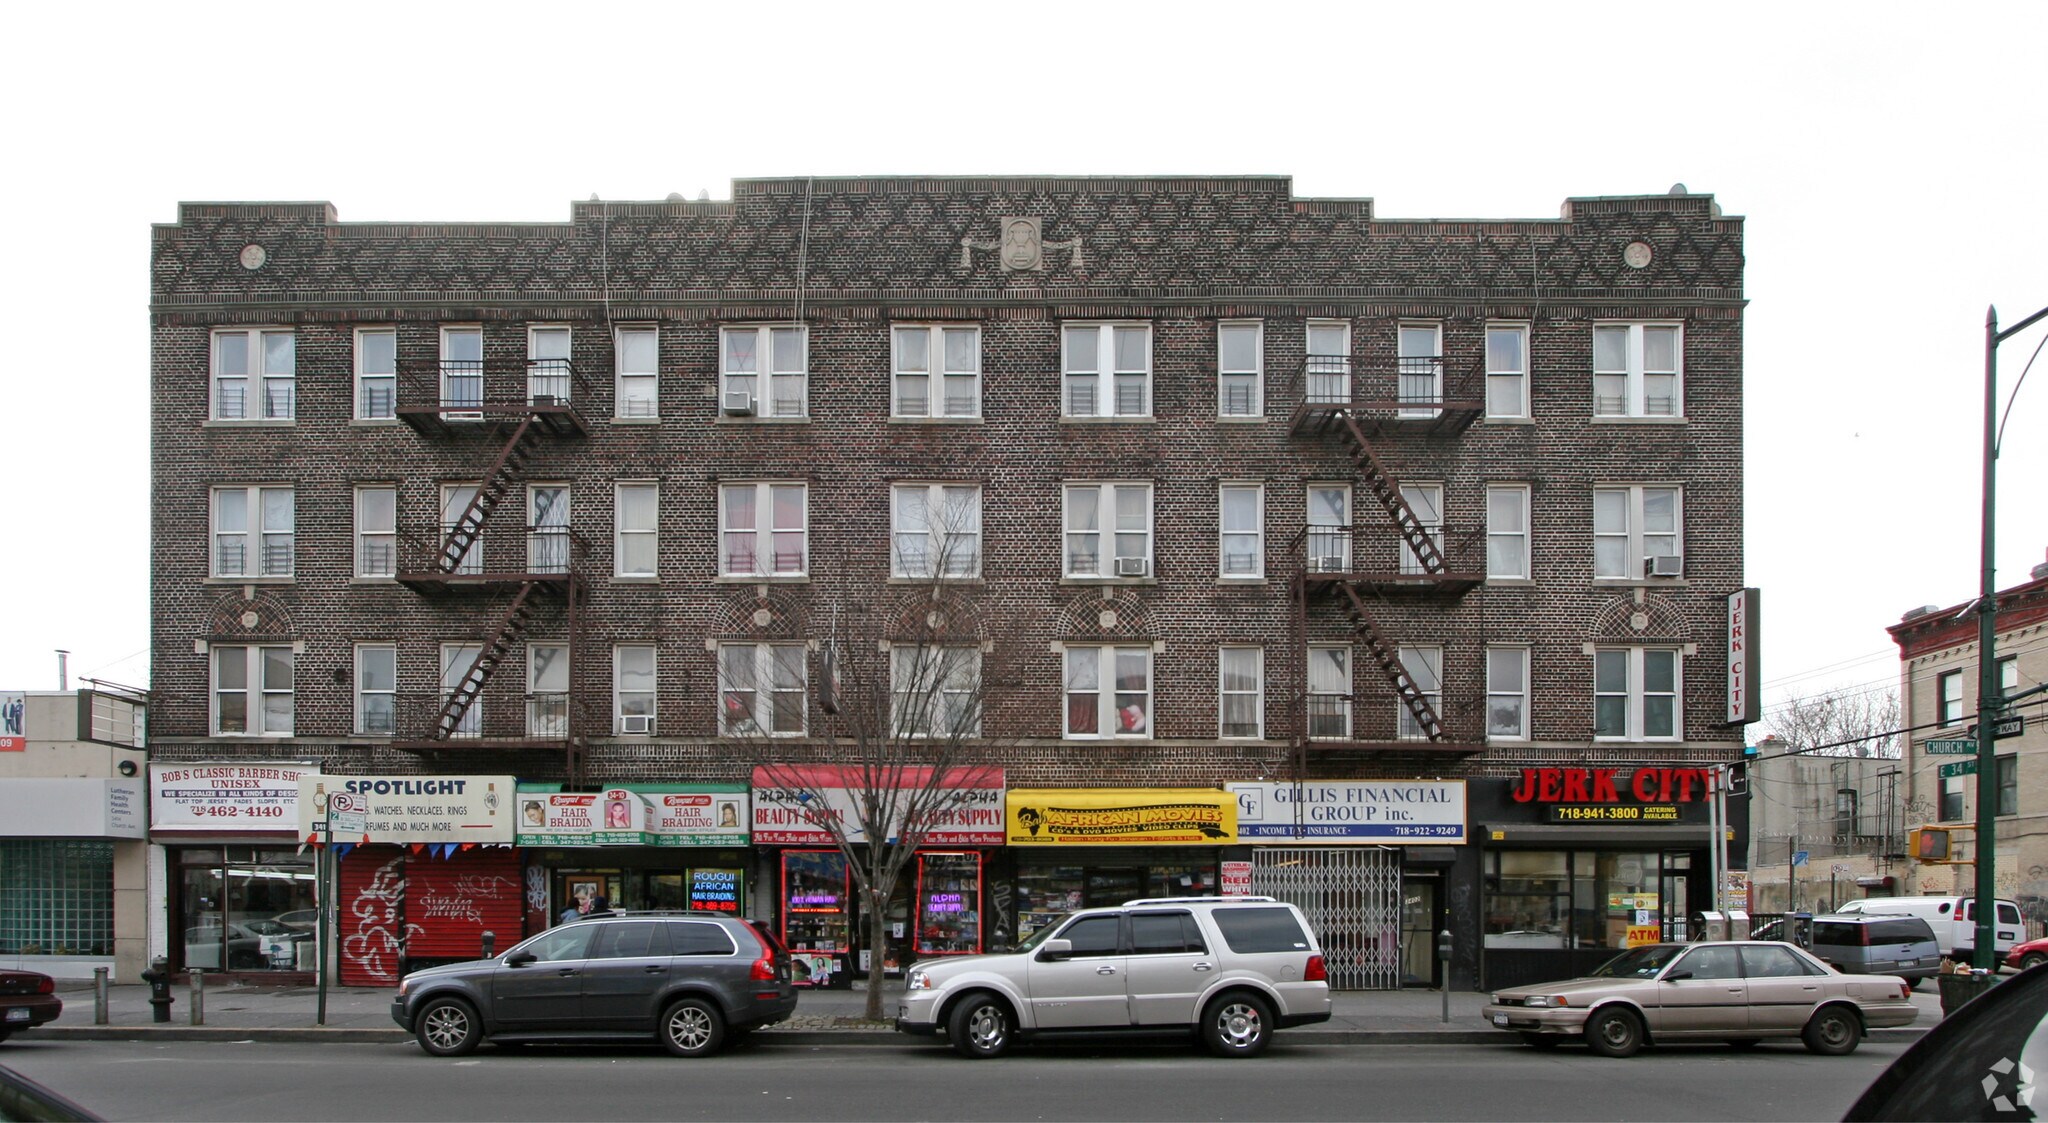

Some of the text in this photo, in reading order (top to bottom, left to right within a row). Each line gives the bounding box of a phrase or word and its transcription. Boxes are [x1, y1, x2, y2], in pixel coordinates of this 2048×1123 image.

[1732, 597, 1743, 653] JERK
[1731, 661, 1743, 716] CITY
[2000, 722, 2018, 733] WAY
[1926, 741, 1963, 754] CHURCH
[161, 767, 303, 783] BOB'S CLASSIC BARBER SHO
[1940, 766, 1946, 777] E
[1951, 764, 1963, 776] 34
[211, 779, 261, 789] UNISEX
[345, 780, 466, 796] SPOTLIGHT
[1512, 767, 1720, 803] JERK CITY
[110, 787, 135, 795] Lutheran
[178, 790, 217, 798] SPECIALIZE
[609, 791, 625, 799] 34-10
[1274, 788, 1451, 803] GILLIS FINANCIAL
[110, 794, 129, 802] Family
[953, 790, 998, 804] ALPHA
[190, 805, 283, 817] 718 462-4140
[448, 805, 468, 816] RINGS
[560, 807, 588, 818] HAIR
[674, 807, 701, 818] HAIR
[1311, 805, 1414, 821] GROUP inc.
[1558, 806, 1639, 820] 718-941-3800
[755, 808, 799, 825] BEAUTY
[958, 808, 1002, 826] SUPPLY
[1047, 810, 1140, 827] AFRICAN
[1145, 808, 1223, 823] MOVIES
[314, 823, 327, 831] 341
[364, 822, 390, 832] RFUMES
[393, 822, 408, 832] AND
[410, 822, 430, 832] MUCH
[432, 822, 452, 832] MORE
[550, 817, 593, 828] BRAIDIN
[662, 817, 713, 828] BRAIDING
[1103, 826, 1138, 834] MOVIES
[1142, 824, 1171, 832] VIDEO
[1258, 826, 1287, 835] INCOME
[1307, 826, 1347, 835] INSURANCE
[693, 872, 735, 881] ROUGUI
[693, 882, 734, 890] AFRICAN
[691, 892, 736, 900] HAIR BRAIDING
[1628, 930, 1659, 940] ATM
